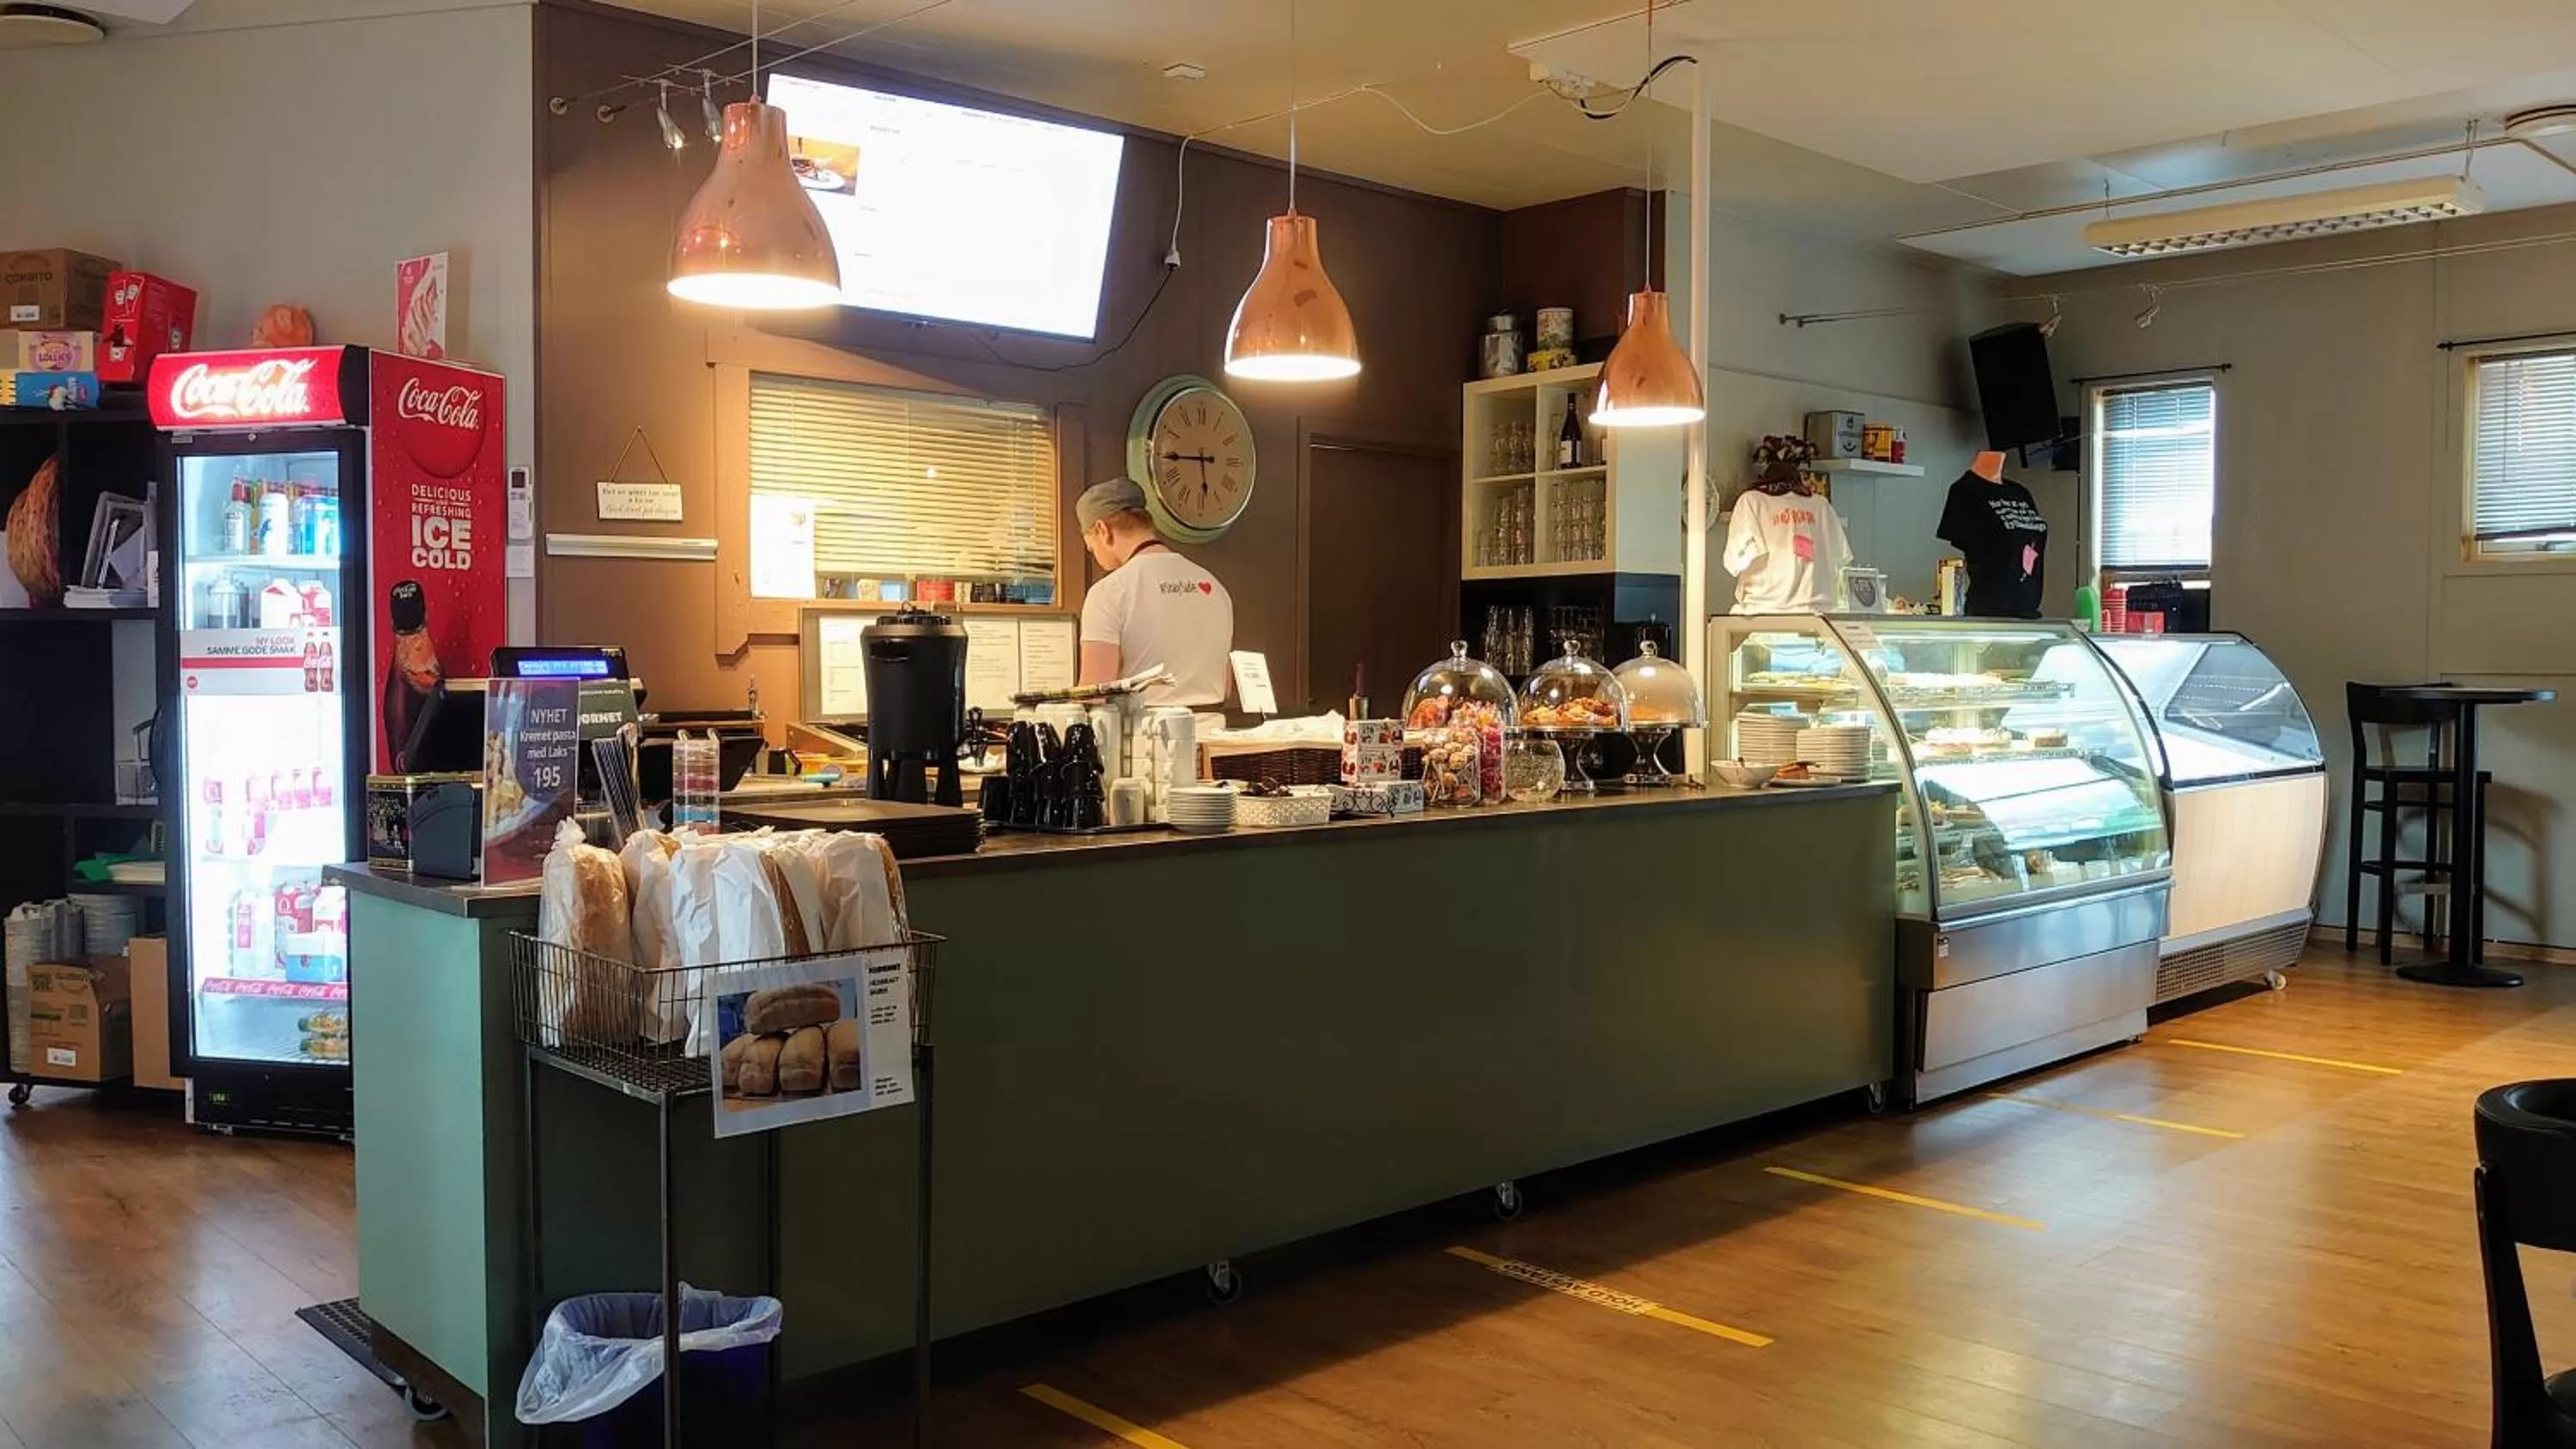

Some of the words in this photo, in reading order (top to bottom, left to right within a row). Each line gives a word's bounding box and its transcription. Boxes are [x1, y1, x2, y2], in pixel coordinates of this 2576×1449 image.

[411, 483, 471, 502] DELICIOUS
[411, 503, 471, 518] REFRESHING
[411, 515, 471, 550] ICE
[411, 547, 471, 571] COLD
[530, 708, 568, 724] NYHET
[519, 731, 551, 743] Kremet
[552, 731, 576, 744] pasta
[526, 746, 547, 760] med
[548, 745, 568, 758] Laks
[532, 765, 561, 789] 195
